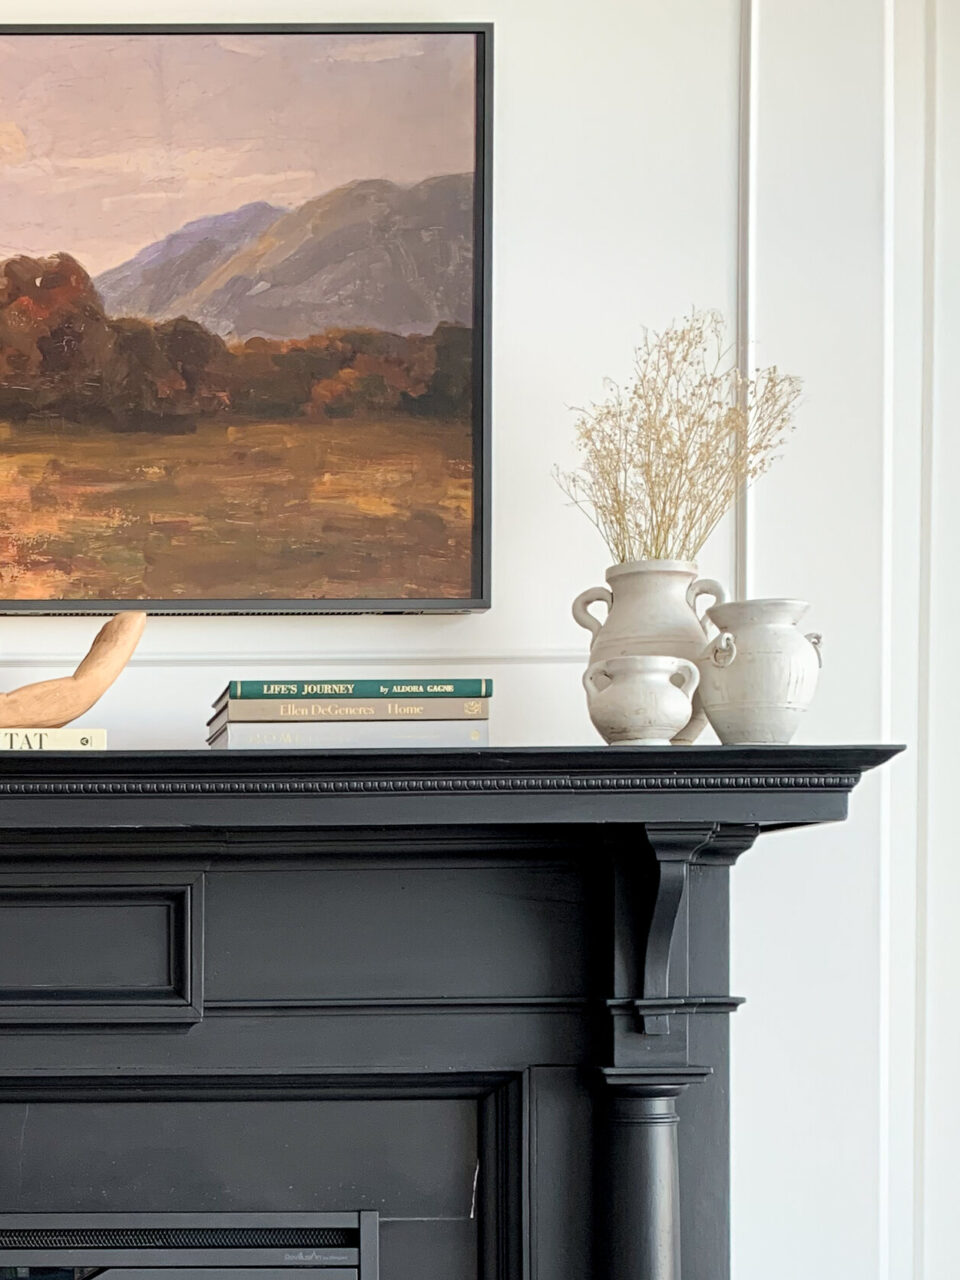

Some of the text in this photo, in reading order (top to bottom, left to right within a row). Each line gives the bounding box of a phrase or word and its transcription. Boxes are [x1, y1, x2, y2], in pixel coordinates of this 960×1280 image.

[263, 684, 297, 694] LIFE'S
[302, 684, 354, 695] JOURNEY
[380, 685, 389, 695] by
[280, 703, 424, 716] Ellen DeGeneres Home
